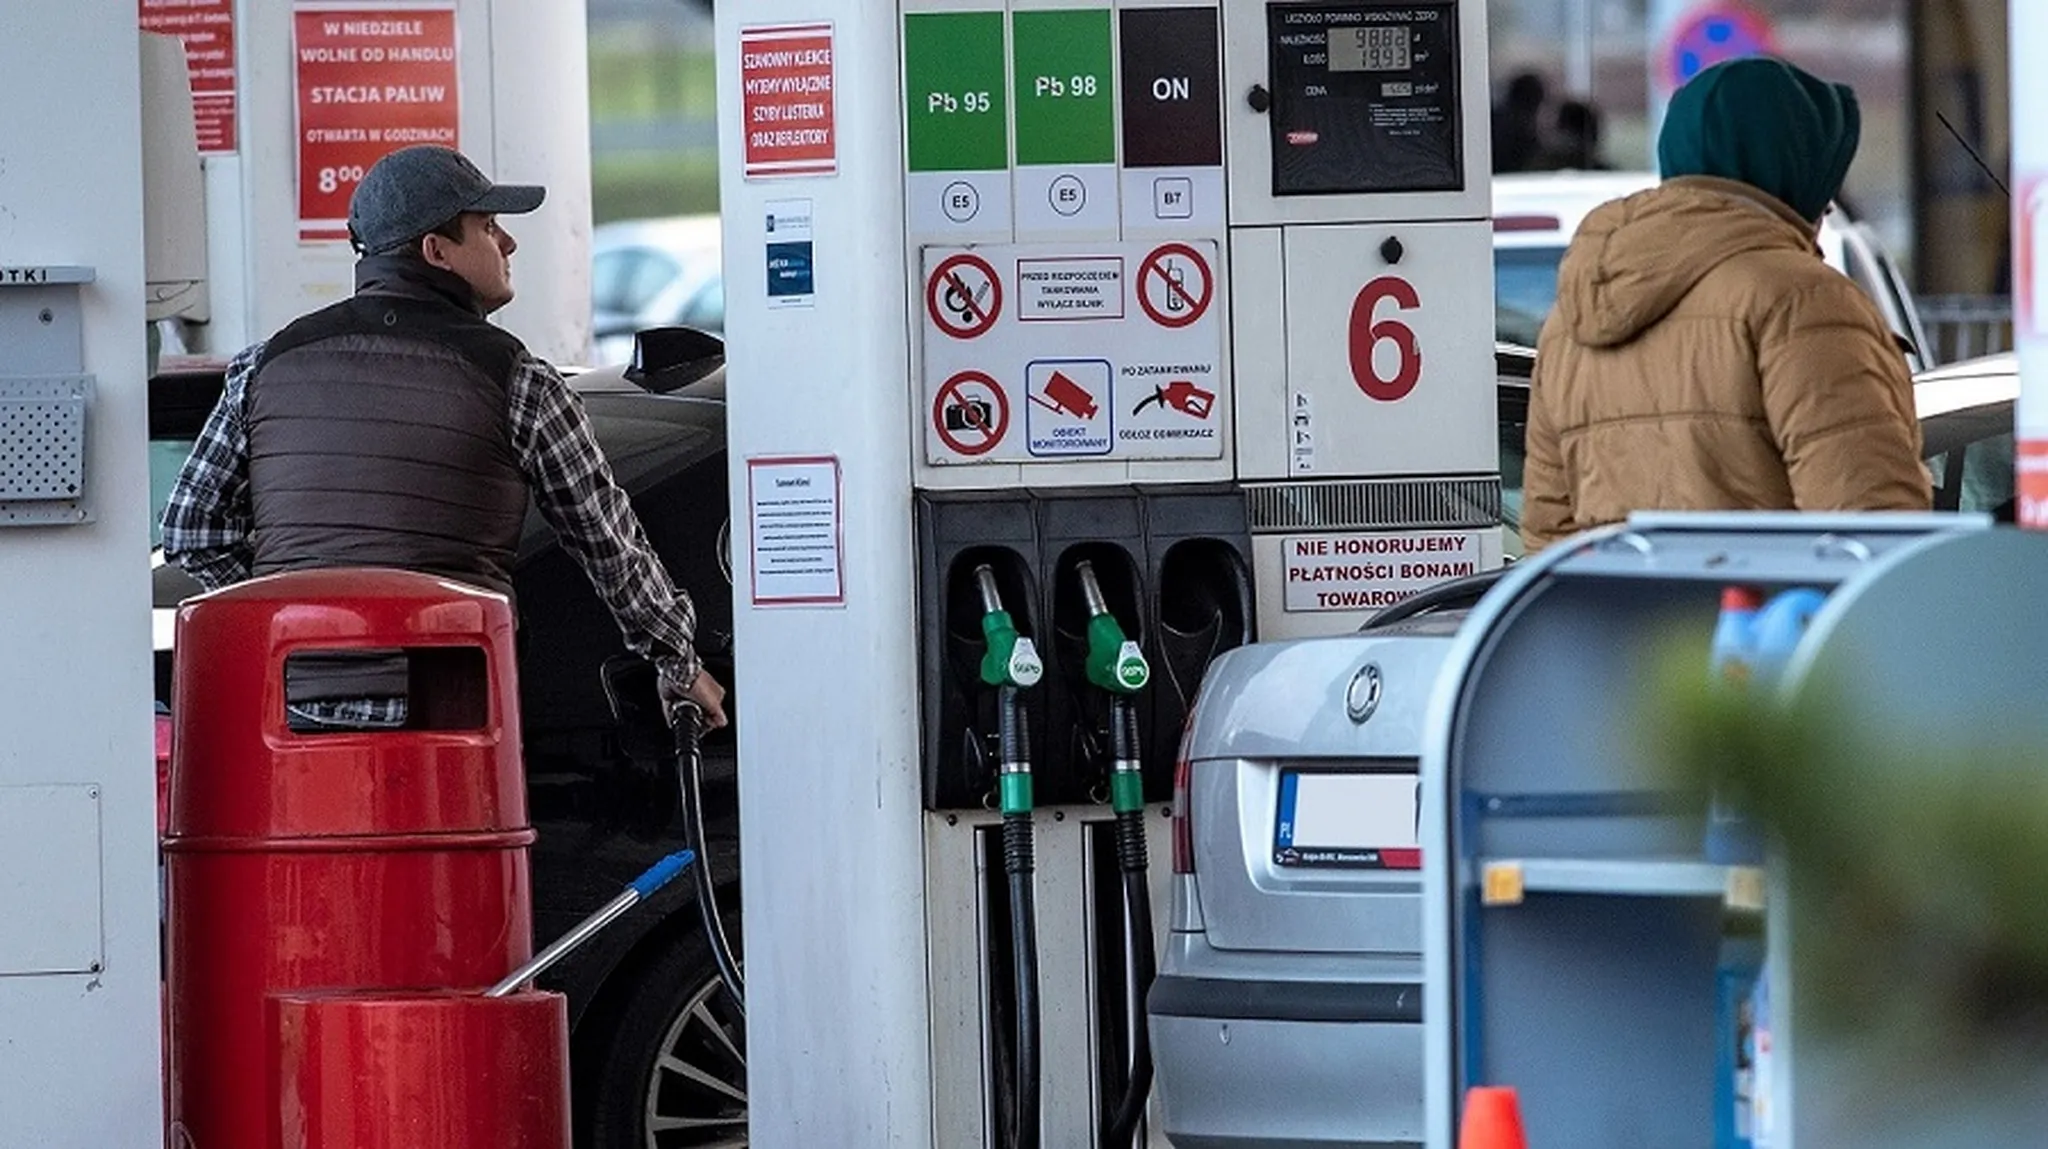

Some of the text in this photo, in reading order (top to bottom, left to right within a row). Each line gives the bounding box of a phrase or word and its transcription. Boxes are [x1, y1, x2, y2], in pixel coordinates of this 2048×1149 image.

[324, 21, 423, 36] W NIEDZIELE
[301, 47, 453, 62] WOLNE OD HANDLU
[311, 86, 445, 103] STACJA PALIW
[1036, 75, 1097, 97] Pb 98
[1152, 78, 1189, 100] ON
[928, 92, 990, 113] Pb 95
[306, 128, 455, 142] OTWARTA W GODZINACH
[952, 195, 970, 208] E5
[1059, 189, 1077, 201] E5
[1164, 192, 1181, 205] B7
[1348, 276, 1422, 402] 6
[1053, 427, 1086, 437] OBIEKT
[1296, 537, 1467, 555] NIE HONORUJEMY
[1290, 562, 1474, 582] PŁATNOŚCI BONAMI
[1317, 589, 1419, 607] TOWAROW
